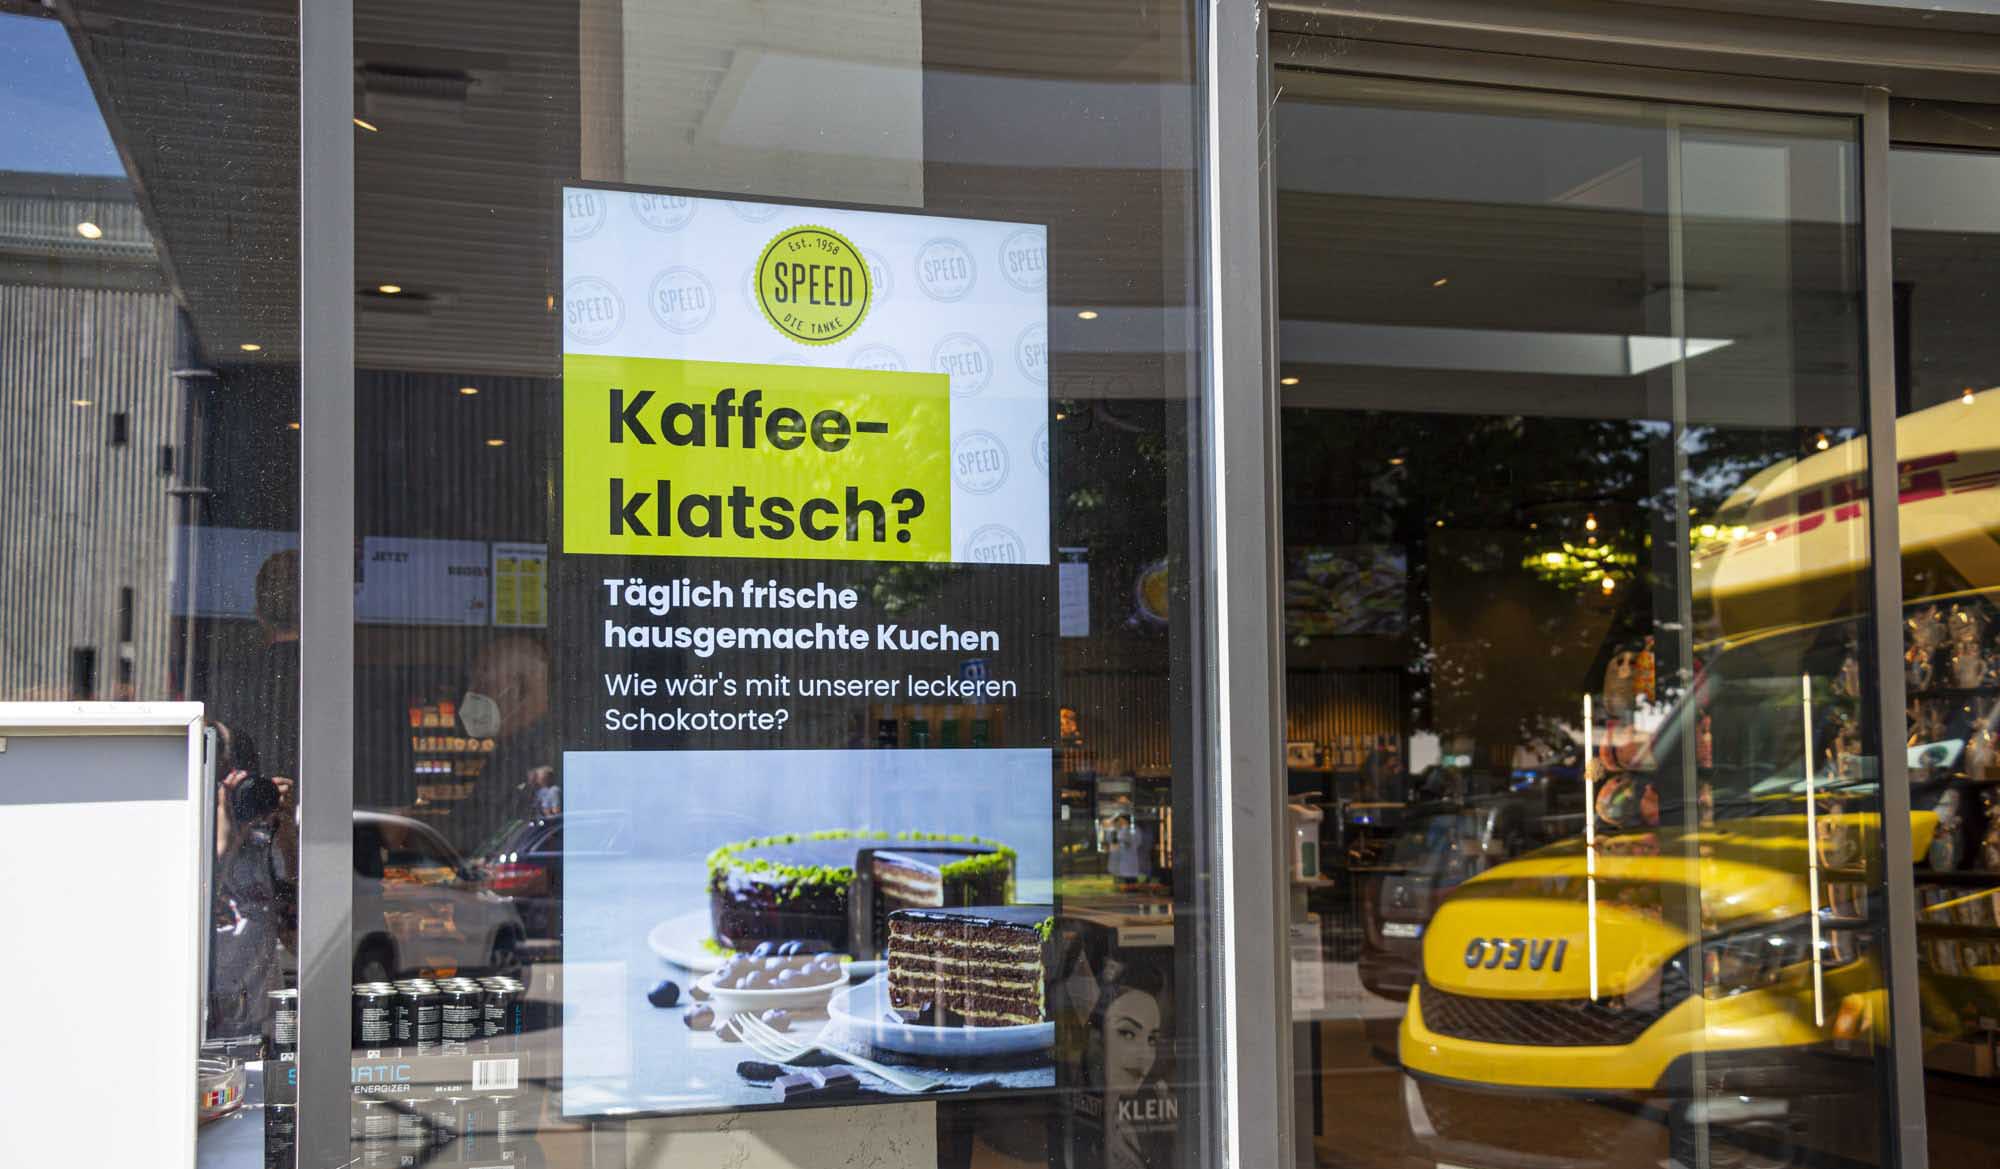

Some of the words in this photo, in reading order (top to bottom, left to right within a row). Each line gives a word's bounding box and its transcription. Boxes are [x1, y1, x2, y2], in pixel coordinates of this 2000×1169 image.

[788, 239, 812, 252] Est.
[816, 238, 840, 256] 1958
[924, 256, 967, 282] SPEED
[775, 262, 853, 307] SPEED
[567, 297, 614, 325] SPEED
[659, 287, 705, 314] SPEED
[783, 313, 802, 331] DIE
[812, 317, 844, 335] TANKE
[939, 351, 983, 377] SPEED
[609, 388, 889, 453] Kaffee-
[958, 447, 1000, 476] SPEED
[609, 478, 926, 544] klatsch?
[603, 577, 734, 616] Täglich
[741, 579, 858, 609] frische
[604, 620, 870, 658] hausgemachte
[876, 624, 1000, 651] Kuchen
[604, 672, 658, 696] Wie
[665, 671, 738, 697] wär's
[746, 673, 791, 697] mit
[798, 678, 900, 697] unserer
[907, 674, 1017, 697] leckeren
[604, 707, 790, 731] Schokotorte?
[354, 1084, 411, 1095] ENERGIZER
[1118, 1099, 1178, 1121] KLEIN
